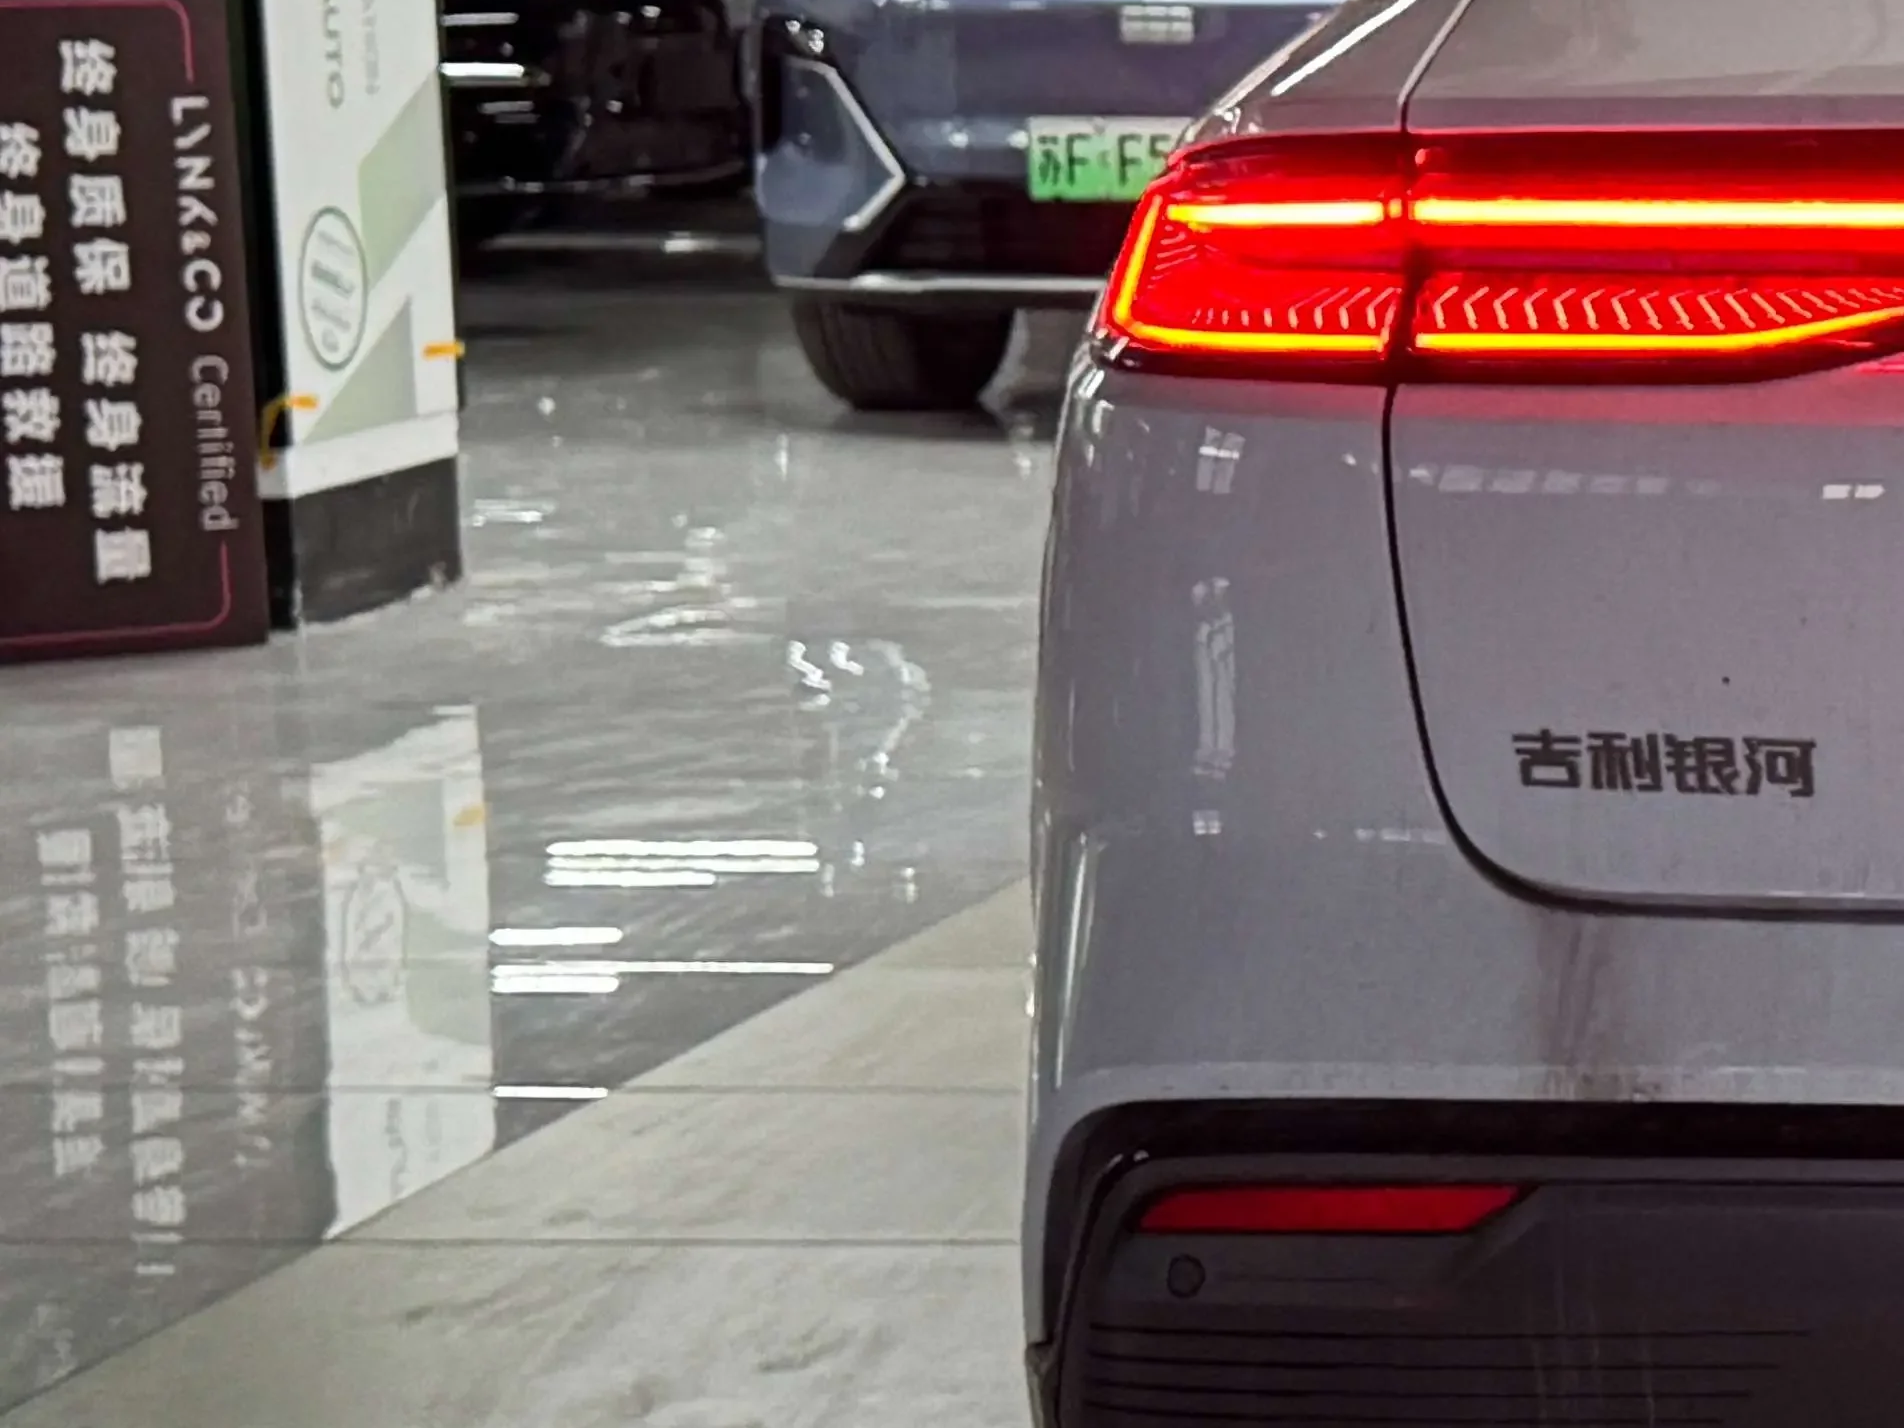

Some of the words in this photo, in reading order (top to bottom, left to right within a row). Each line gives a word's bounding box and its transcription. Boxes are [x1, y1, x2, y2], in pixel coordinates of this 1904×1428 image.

[59, 39, 131, 295] 终身质保
[80, 332, 152, 585] 终身流量
[188, 354, 239, 531] Certified
[1512, 729, 1816, 797] 吉利银河
